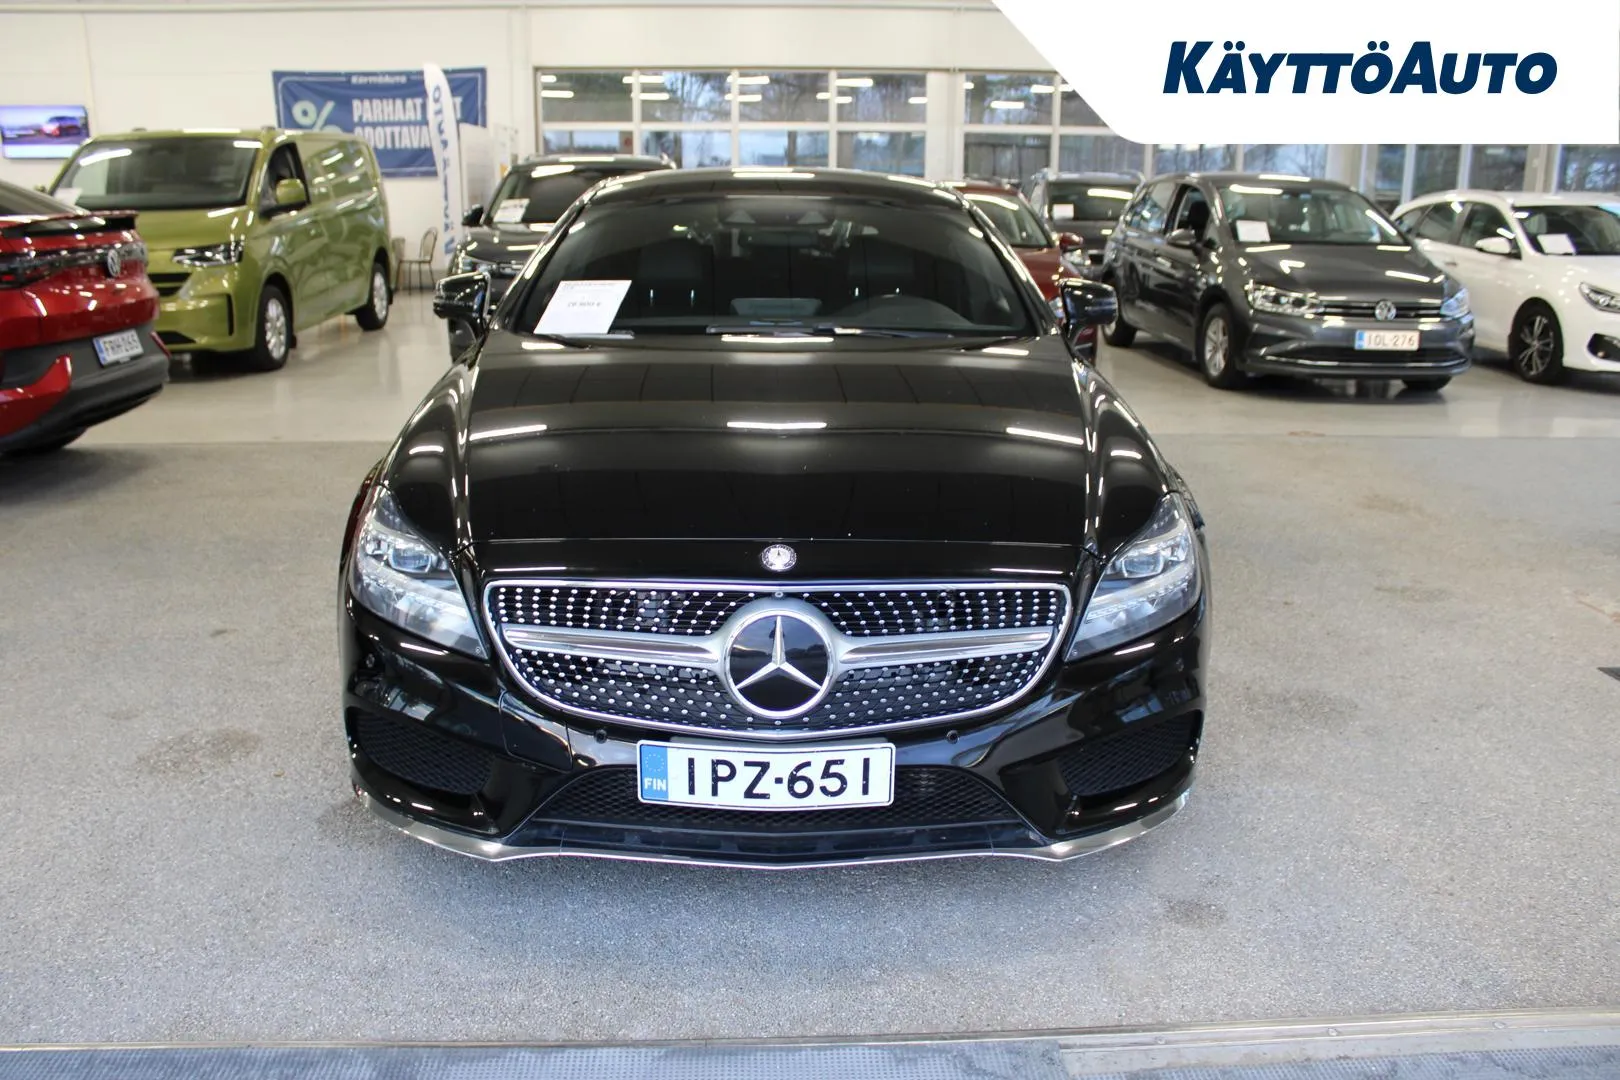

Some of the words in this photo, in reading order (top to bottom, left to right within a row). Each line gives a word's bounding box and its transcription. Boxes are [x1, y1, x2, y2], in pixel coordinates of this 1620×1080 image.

[352, 97, 423, 123] PARHAAT
[643, 777, 668, 792] FIN
[687, 757, 871, 800] IPZ-651
